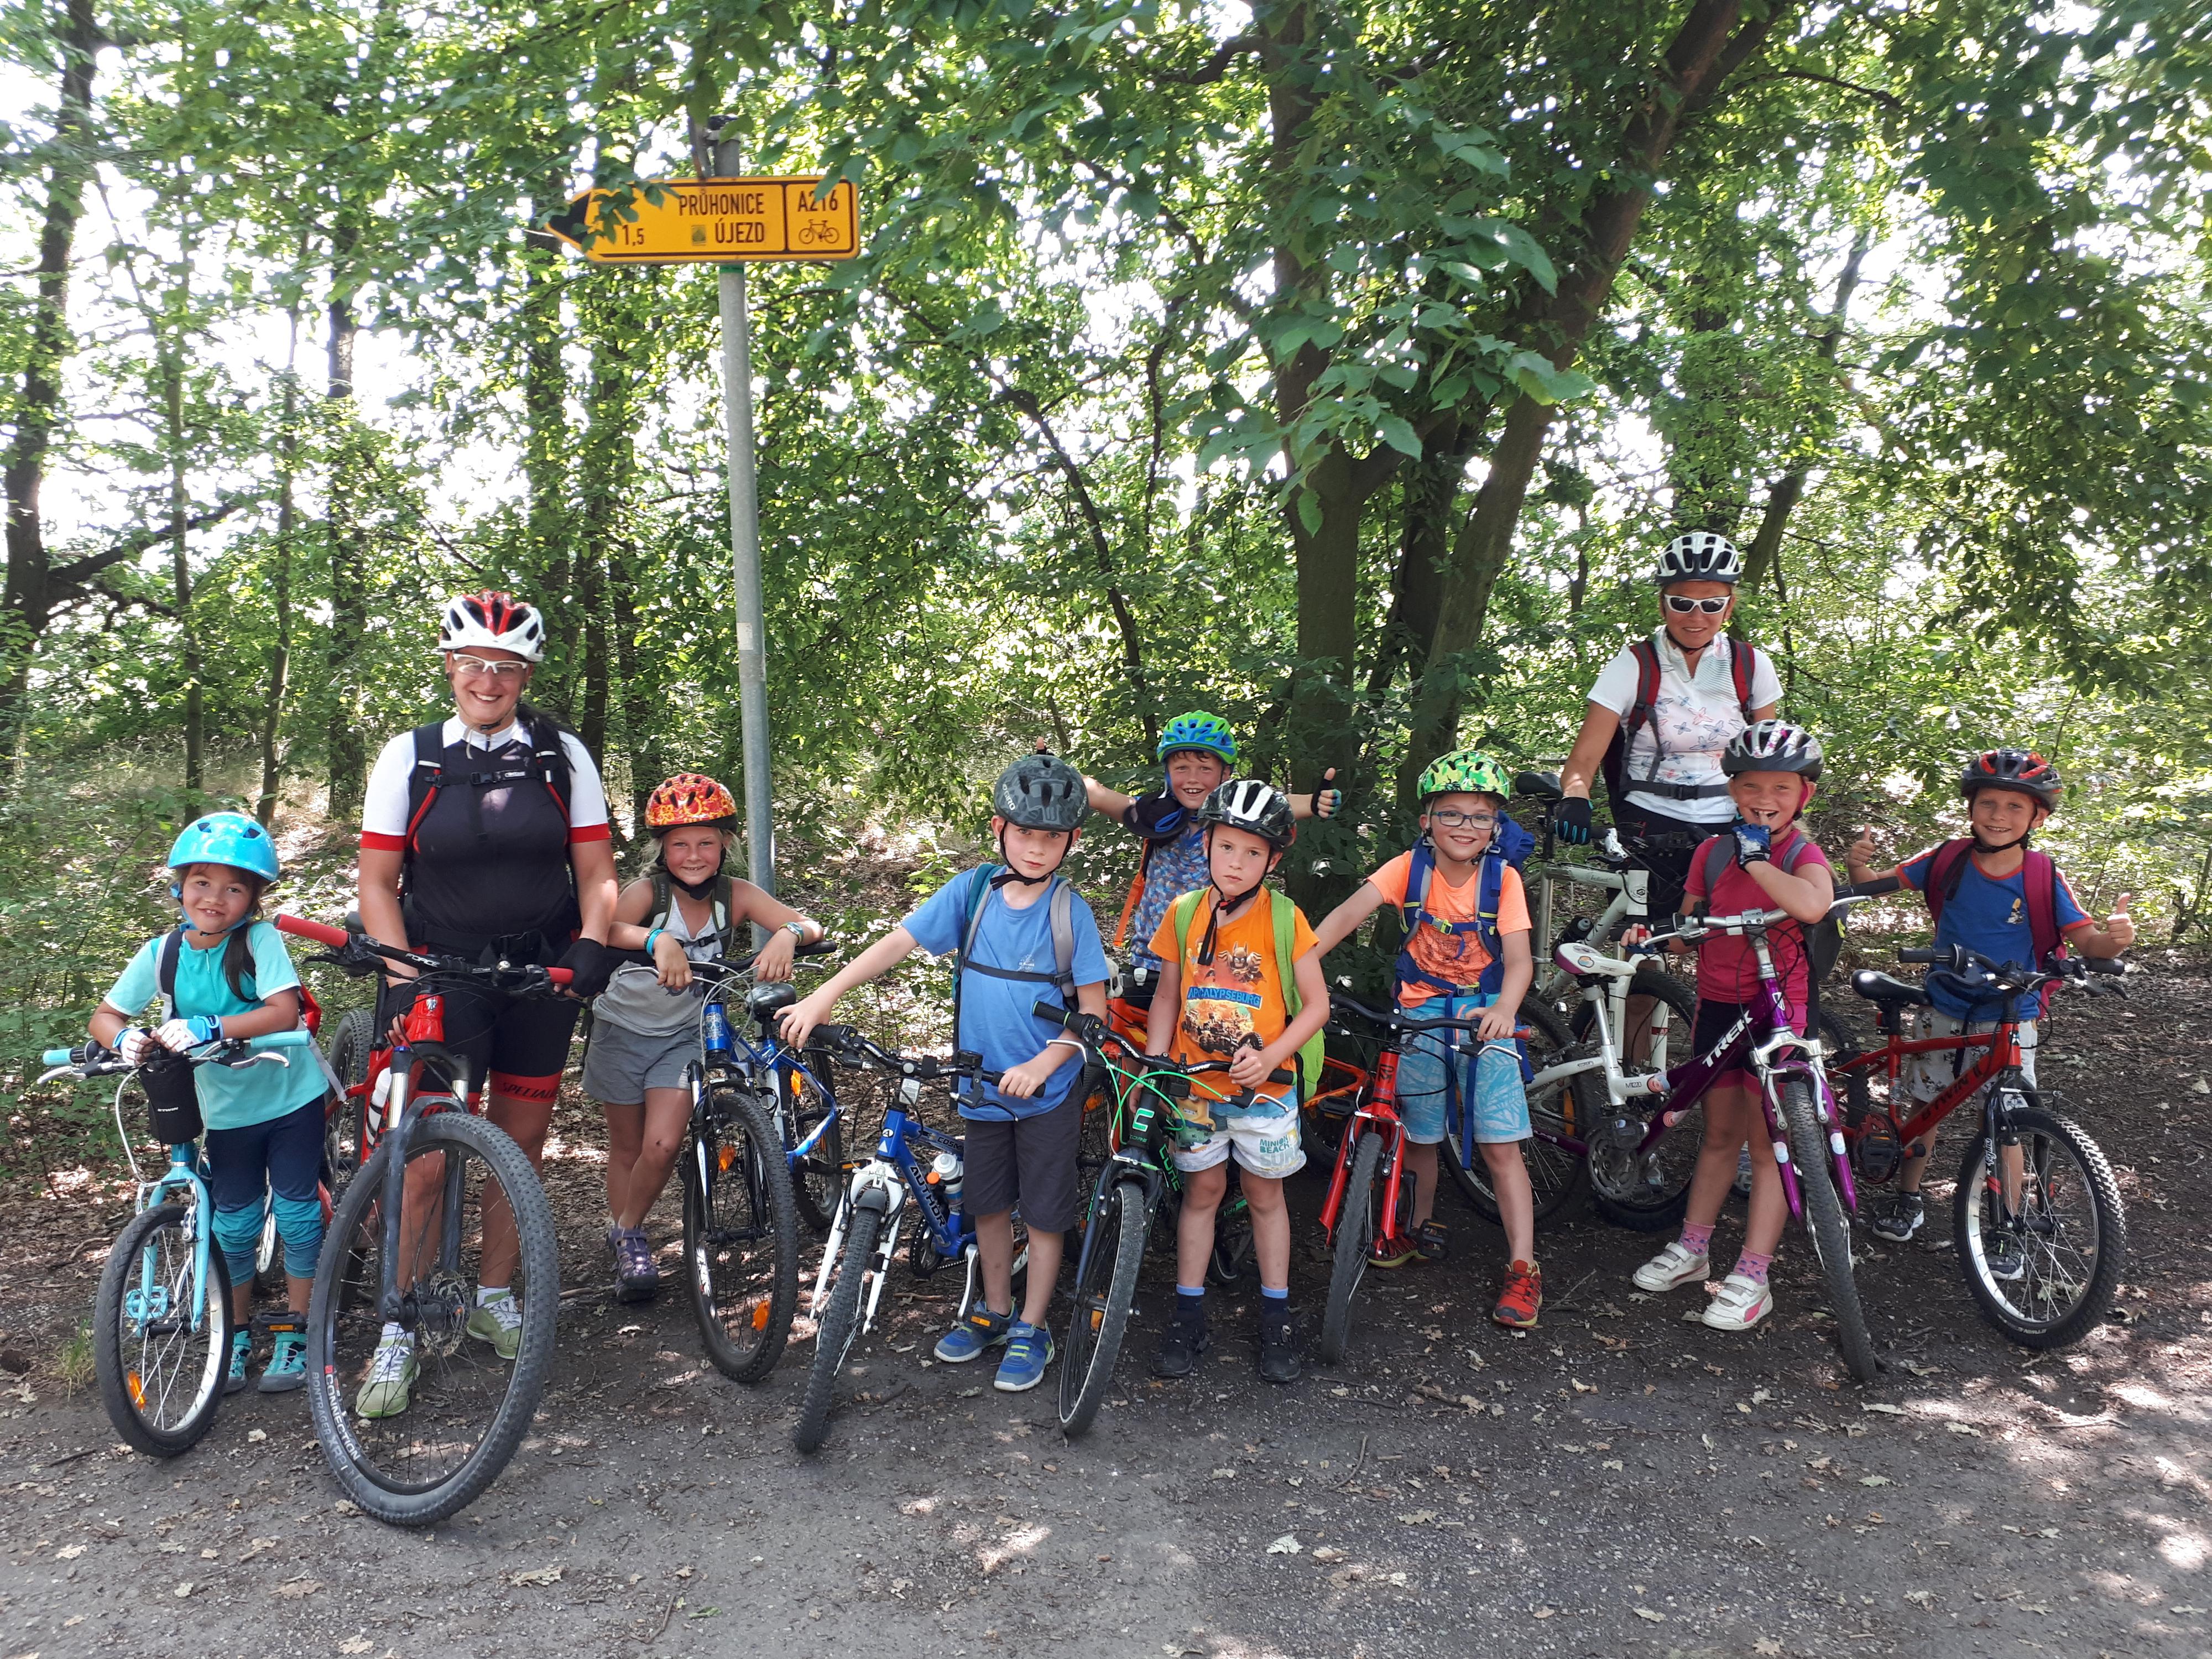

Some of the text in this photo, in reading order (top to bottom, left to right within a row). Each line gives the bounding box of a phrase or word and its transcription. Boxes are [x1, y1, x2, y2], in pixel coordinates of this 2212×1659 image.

[679, 189, 764, 216] PRŮHONICE
[797, 190, 838, 212] A216
[622, 225, 644, 247] 1,5
[715, 217, 764, 243] ÚJEZD
[1004, 791, 1015, 811] GIRO
[405, 953, 440, 968] FORCE
[1120, 1040, 1140, 1058] CORE
[1702, 1010, 1754, 1067] TREK
[1187, 1063, 1211, 1073] CORE
[937, 1136, 964, 1150] COSM
[1130, 1135, 1147, 1143] CORE
[1260, 1134, 1288, 1147] MINION
[910, 1166, 946, 1227] AUTHOR
[312, 1371, 331, 1436] BONTRAGER
[325, 1374, 361, 1461] CONNECTION
